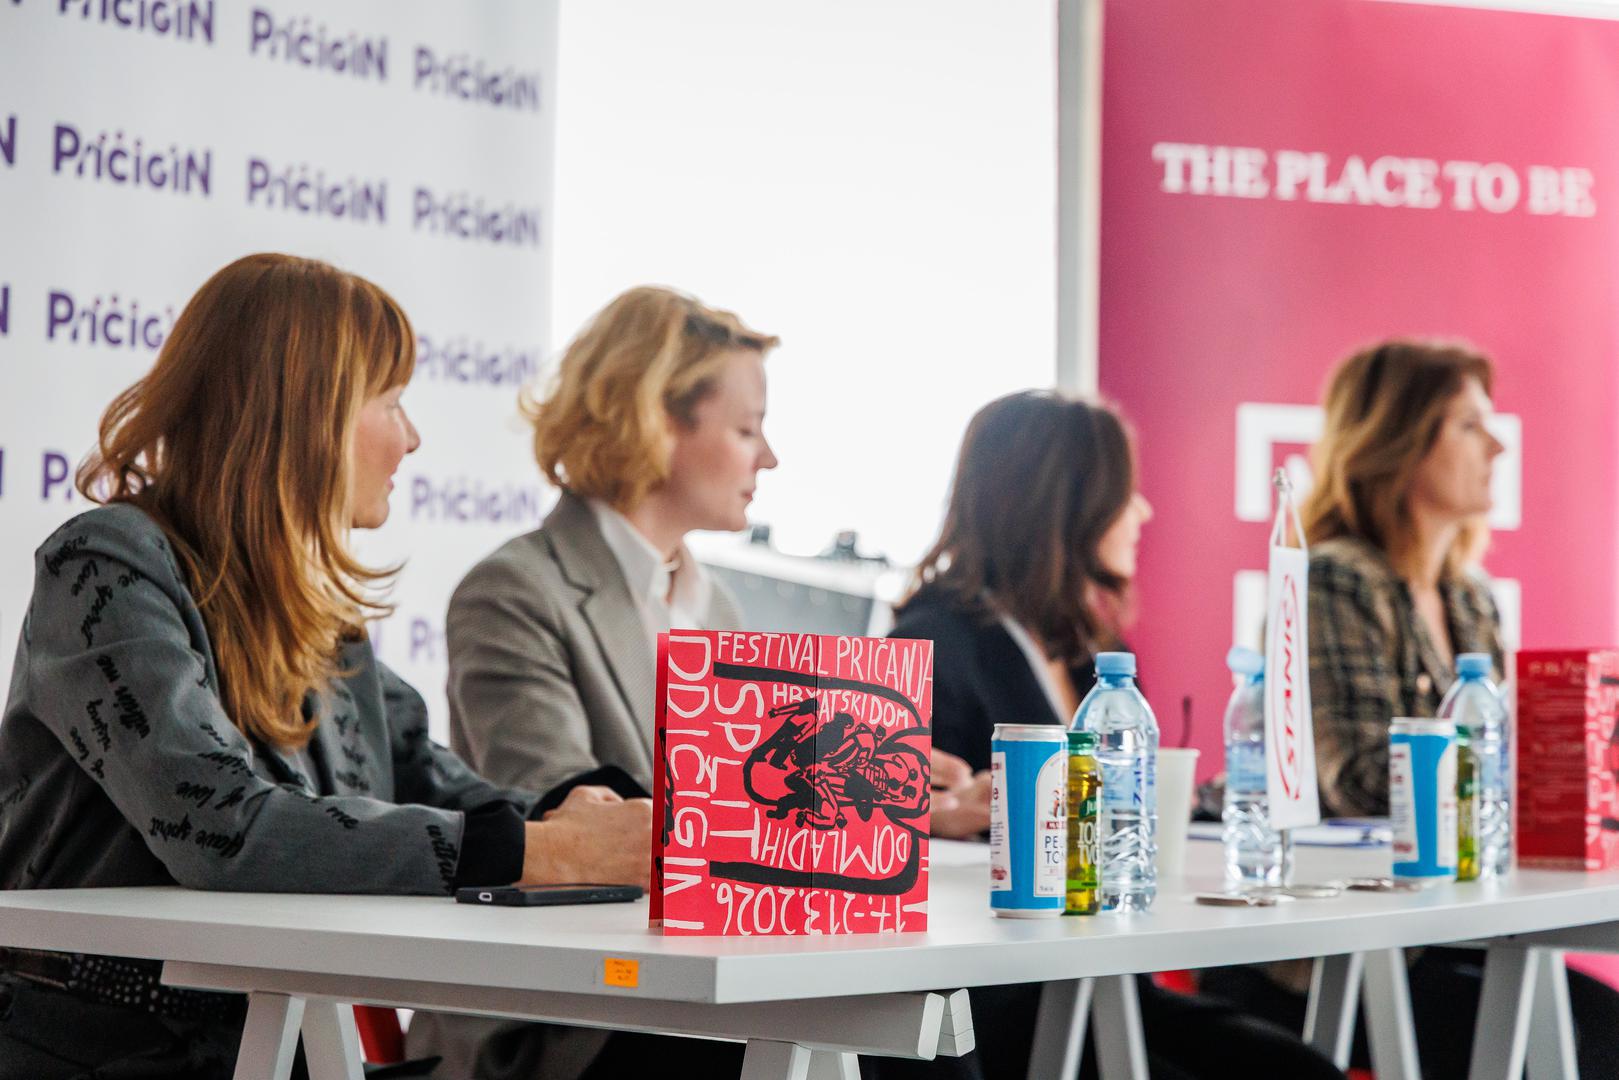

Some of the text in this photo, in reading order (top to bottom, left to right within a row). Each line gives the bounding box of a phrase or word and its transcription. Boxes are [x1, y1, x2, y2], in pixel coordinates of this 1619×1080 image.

[1152, 142, 1270, 199] THE
[1275, 149, 1441, 209] PLACE
[1444, 160, 1520, 214] TO
[717, 632, 934, 709] FESTIVAL PRIČANJA
[773, 684, 909, 729] HRVATSKI DOM
[711, 683, 765, 861] SPLIT
